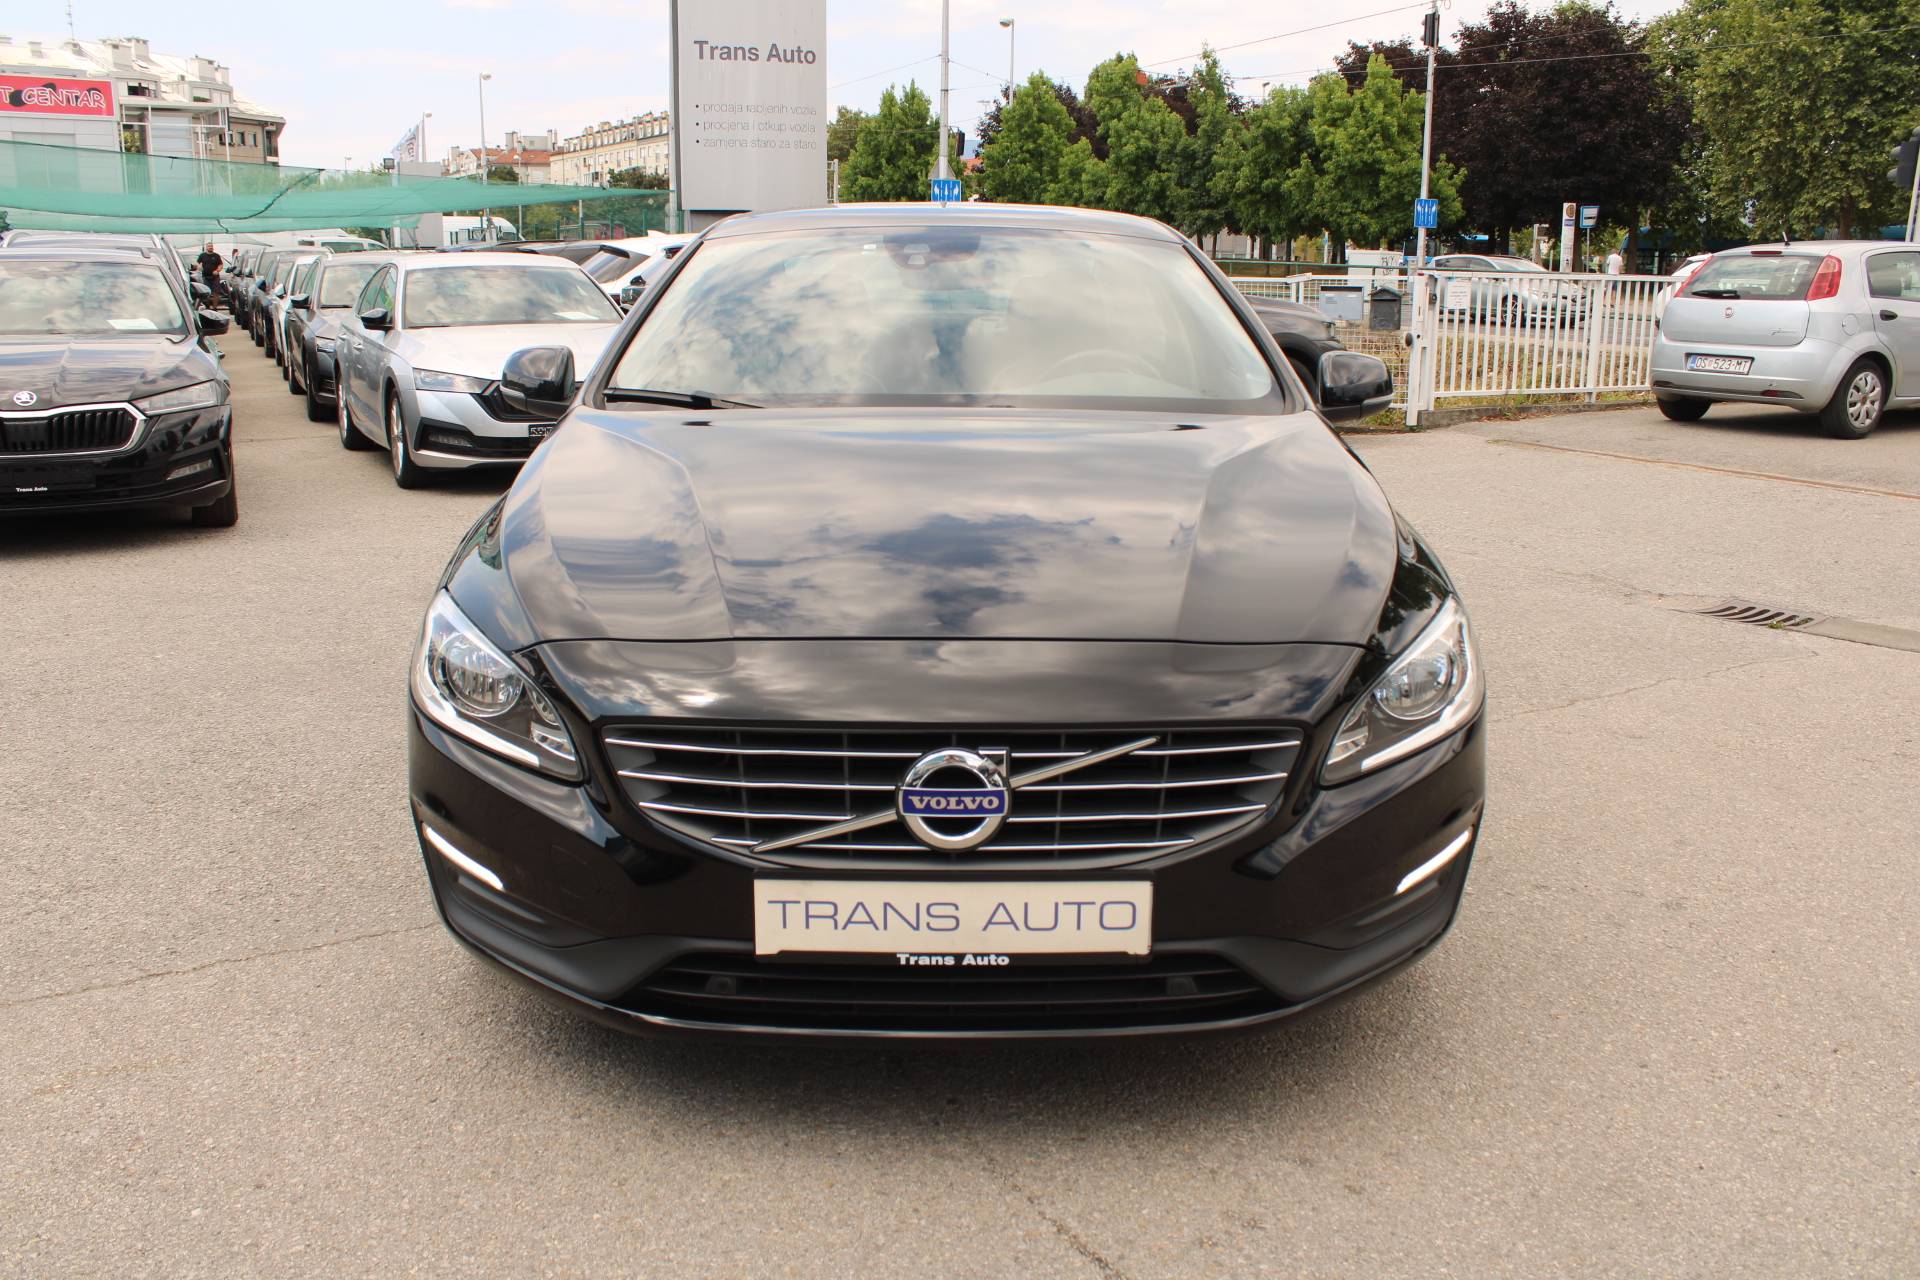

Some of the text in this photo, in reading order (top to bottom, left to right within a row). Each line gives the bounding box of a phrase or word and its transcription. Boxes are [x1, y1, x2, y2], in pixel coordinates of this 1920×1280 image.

[694, 40, 816, 65] Trans Auto
[22, 87, 105, 108] CENTAR
[703, 102, 743, 115] prodaja
[790, 105, 817, 116] vozila
[703, 120, 749, 132] procjena
[758, 120, 787, 133] otkup
[789, 122, 816, 133] vozila
[703, 137, 817, 150] zamjena staro za staro
[908, 796, 1000, 810] VOLVO
[768, 900, 1137, 932] TRANS AUTO
[897, 953, 1010, 966] Trans Auto
